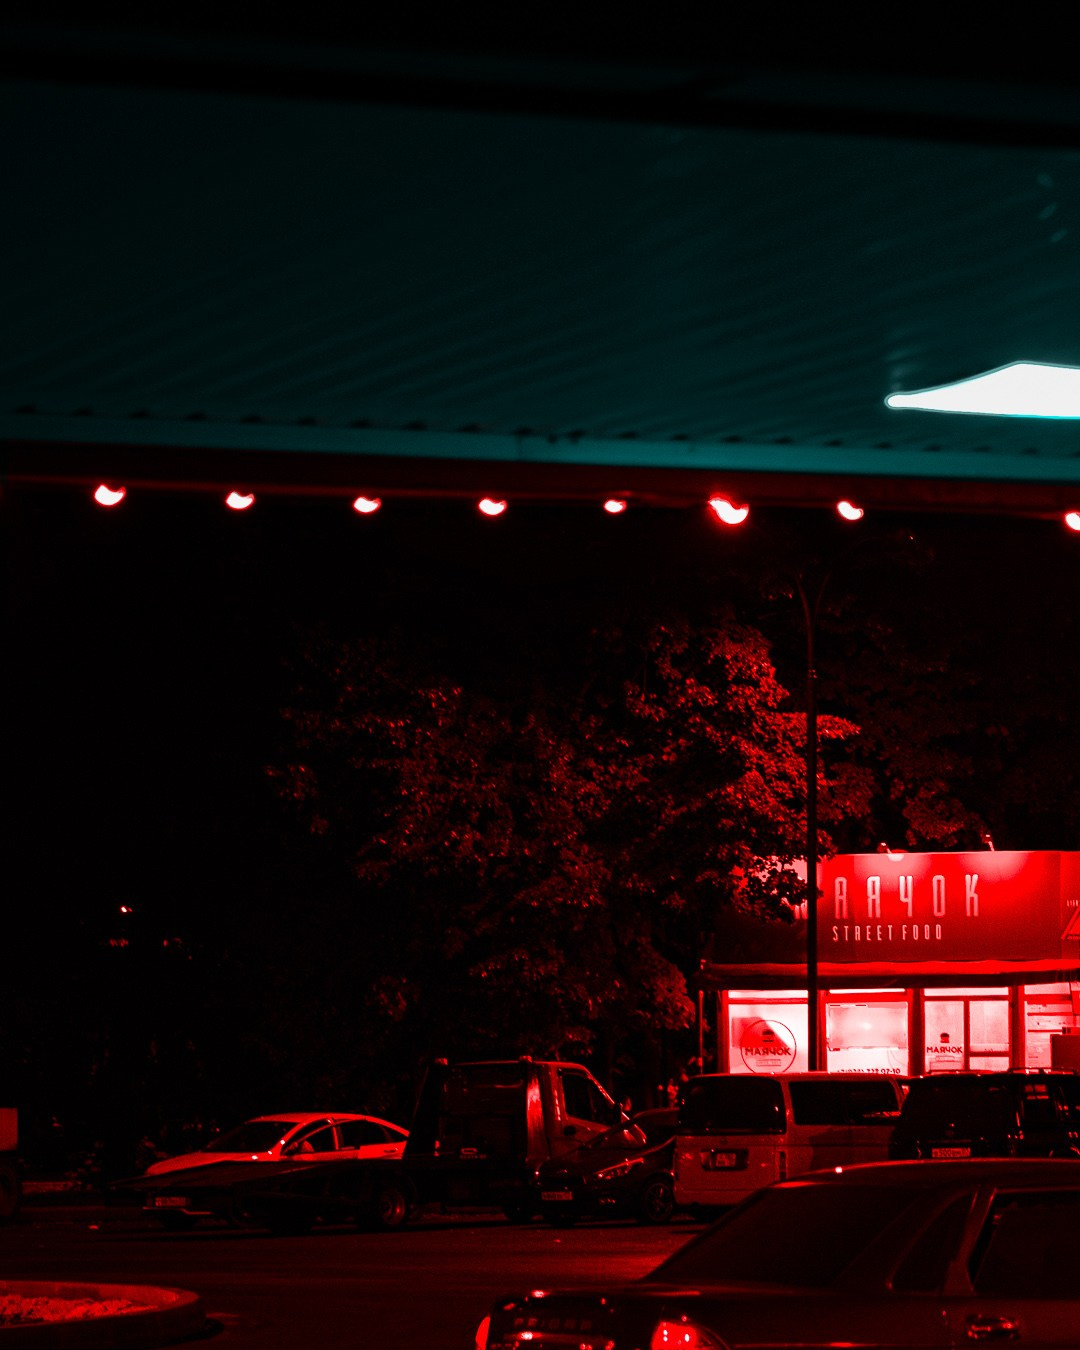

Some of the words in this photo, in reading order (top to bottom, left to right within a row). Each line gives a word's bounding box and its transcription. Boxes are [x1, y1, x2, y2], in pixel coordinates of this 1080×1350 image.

[832, 924, 893, 942] STREET
[902, 924, 942, 941] FOOD
[745, 1047, 791, 1056] МАЯЧОК
[927, 1046, 963, 1054] МАЯЧОК
